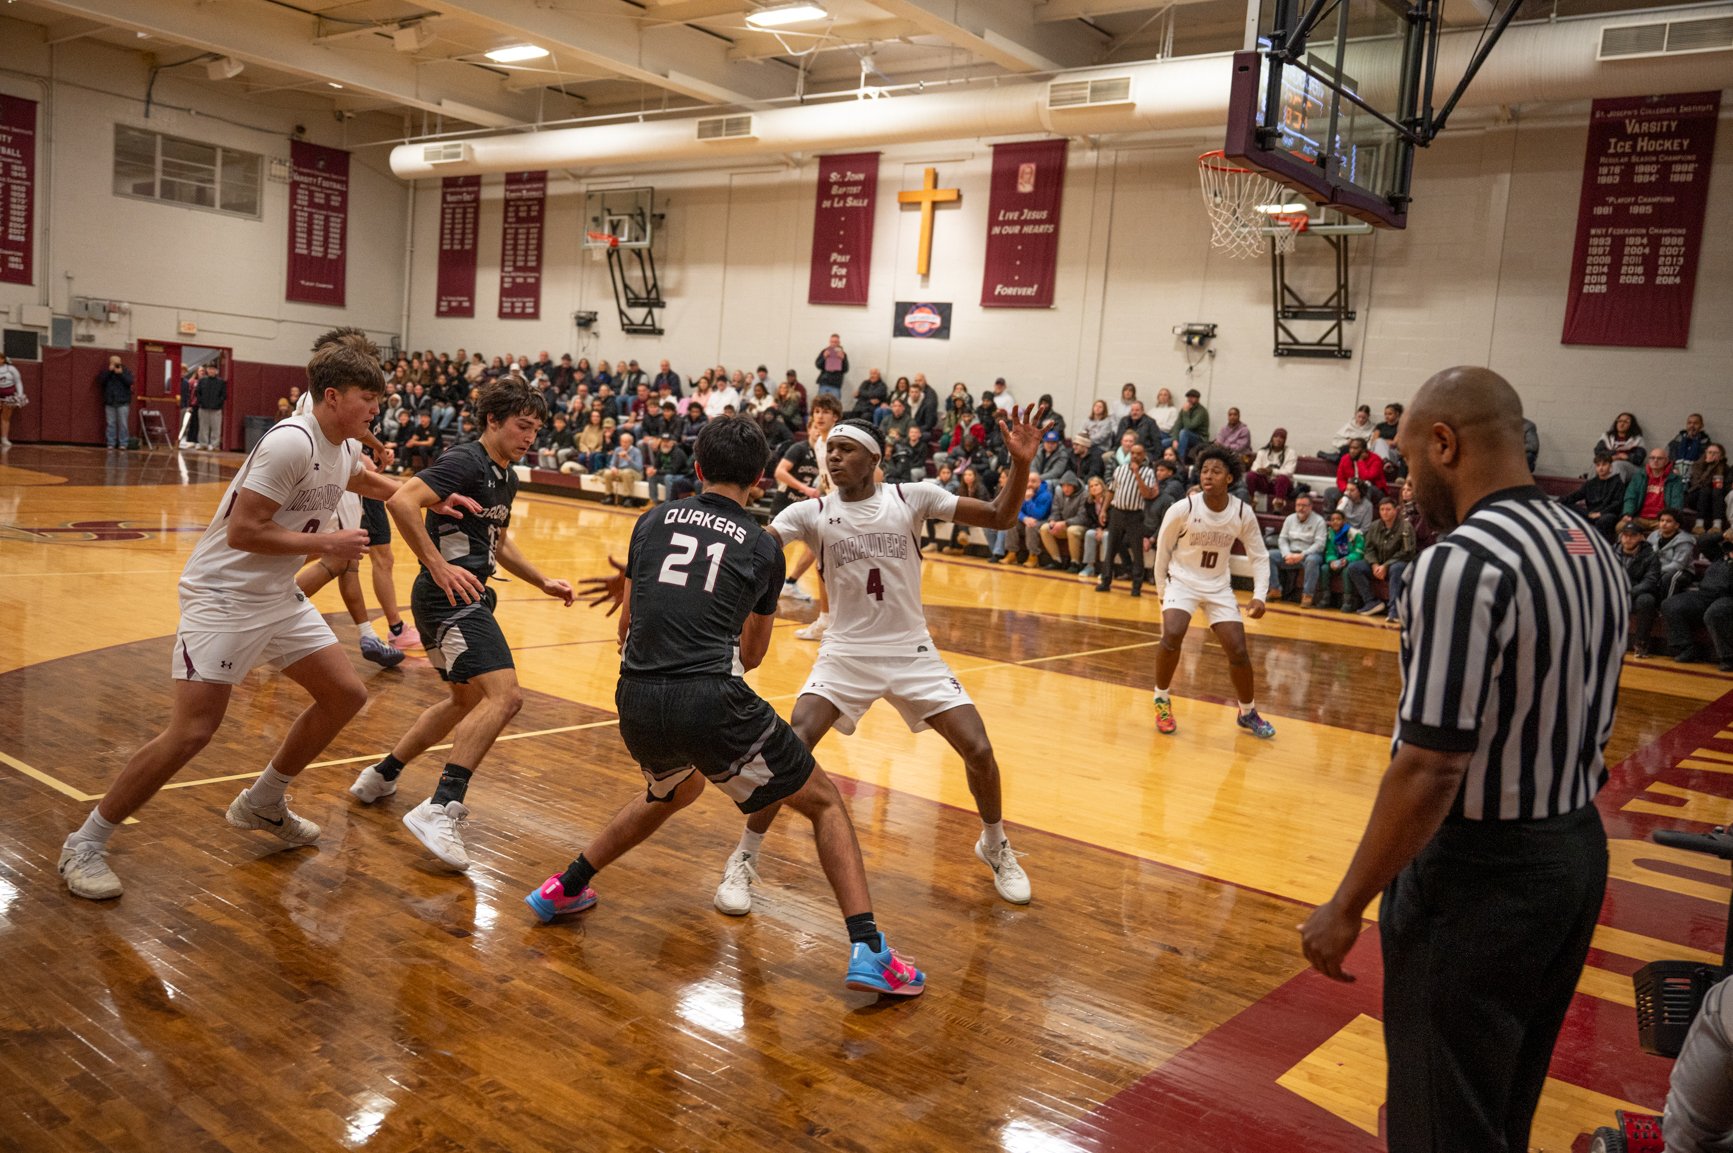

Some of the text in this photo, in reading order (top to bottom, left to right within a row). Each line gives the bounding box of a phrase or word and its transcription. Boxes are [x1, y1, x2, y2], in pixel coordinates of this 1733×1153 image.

[1625, 118, 1678, 135] VARSITY
[1607, 136, 1690, 153] ICE HOCKEY
[844, 171, 865, 181] JOHN
[831, 184, 862, 195] BAPTIST
[845, 196, 868, 207] SALLE
[998, 208, 1048, 221] LIVE JESUS
[991, 224, 1055, 235] IN OUR HEARTS
[1624, 246, 1650, 255] 2004
[1659, 246, 1686, 256] 2007
[830, 252, 850, 263] PRAY
[1622, 255, 1642, 265] 2011
[1658, 256, 1684, 266] 2013
[831, 265, 847, 276] FOR
[1585, 265, 1609, 274] 2014
[1658, 265, 1680, 275] 2017
[994, 284, 1038, 296] FOREVER!
[1583, 284, 1608, 294] 2025
[664, 508, 747, 545] QUAKERS
[830, 532, 907, 569] MARAUDERS
[658, 531, 726, 593] 21
[1200, 550, 1219, 569] 10
[866, 568, 884, 601] 4
